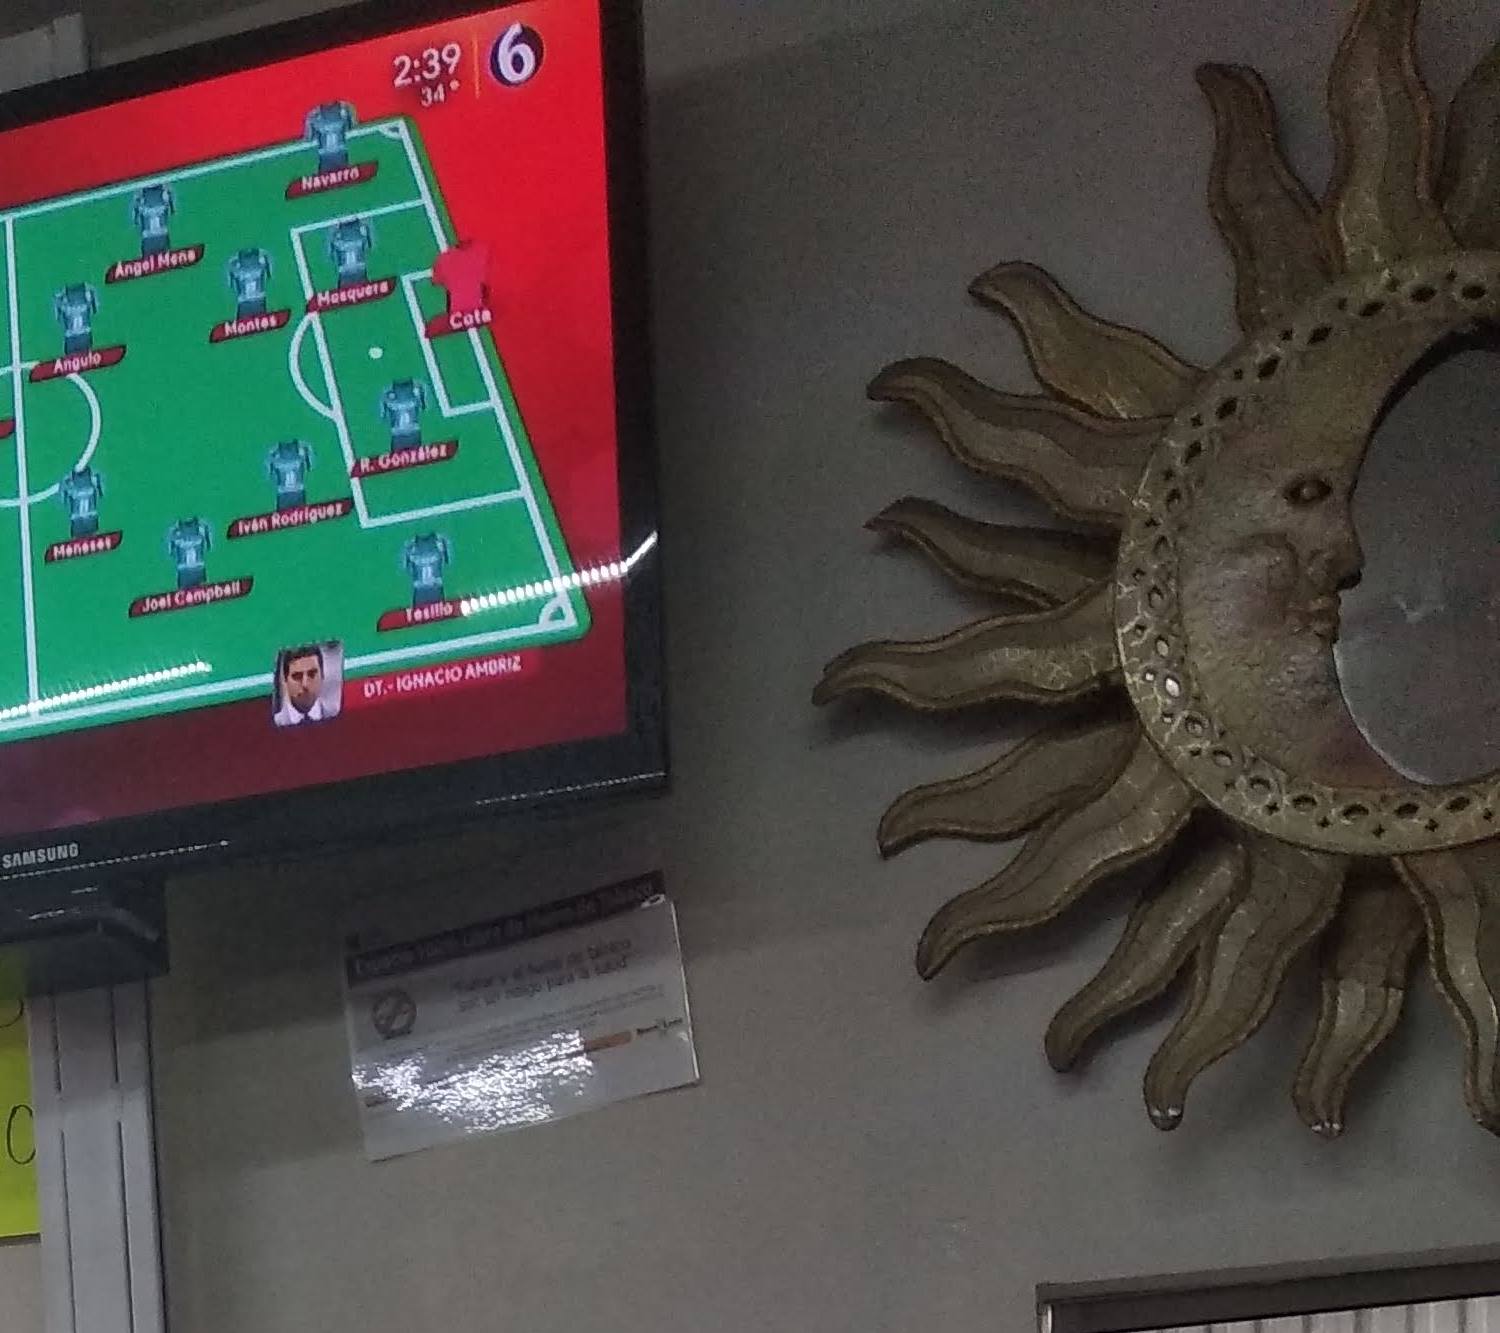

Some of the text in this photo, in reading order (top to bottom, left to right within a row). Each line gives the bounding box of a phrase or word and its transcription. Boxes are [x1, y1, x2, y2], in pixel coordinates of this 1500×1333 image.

[392, 22, 536, 88] 2:39 6
[301, 166, 360, 191] Navarro
[157, 248, 197, 270] Mena
[316, 281, 390, 306] Mosquera
[224, 314, 278, 338] Montes
[449, 308, 492, 330] Cota
[53, 351, 102, 376] Angulo
[52, 538, 112, 560] Meneses
[141, 581, 242, 613] Joel Campbell
[405, 601, 454, 624] Tesillo
[396, 665, 463, 693] IGNACIO
[2, 842, 80, 869] SAMSUNG
